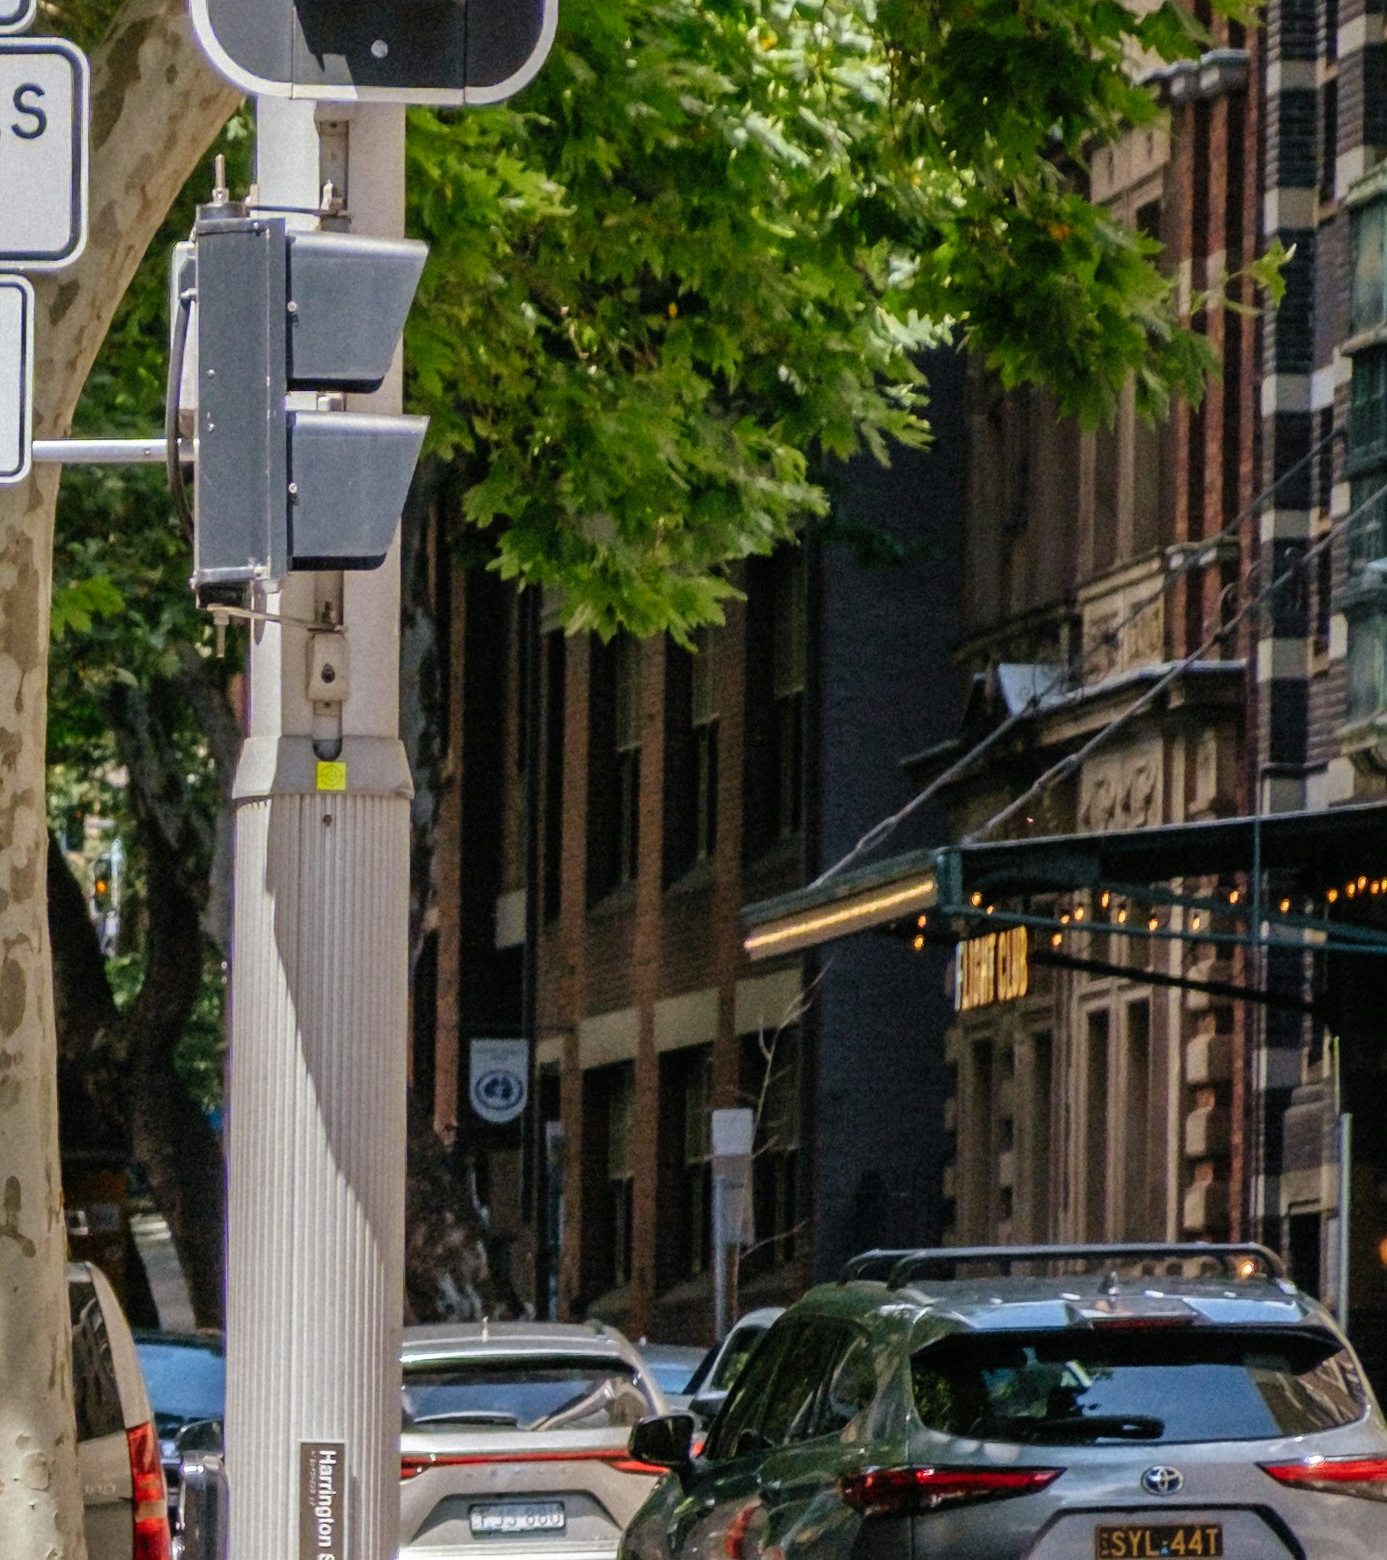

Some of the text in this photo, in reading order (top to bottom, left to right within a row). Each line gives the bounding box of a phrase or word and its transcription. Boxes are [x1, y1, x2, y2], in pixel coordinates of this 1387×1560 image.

[314, 1450, 337, 1547] Harrington
[1110, 1530, 1160, 1557] SYL
[1170, 1528, 1219, 1556] 44T
